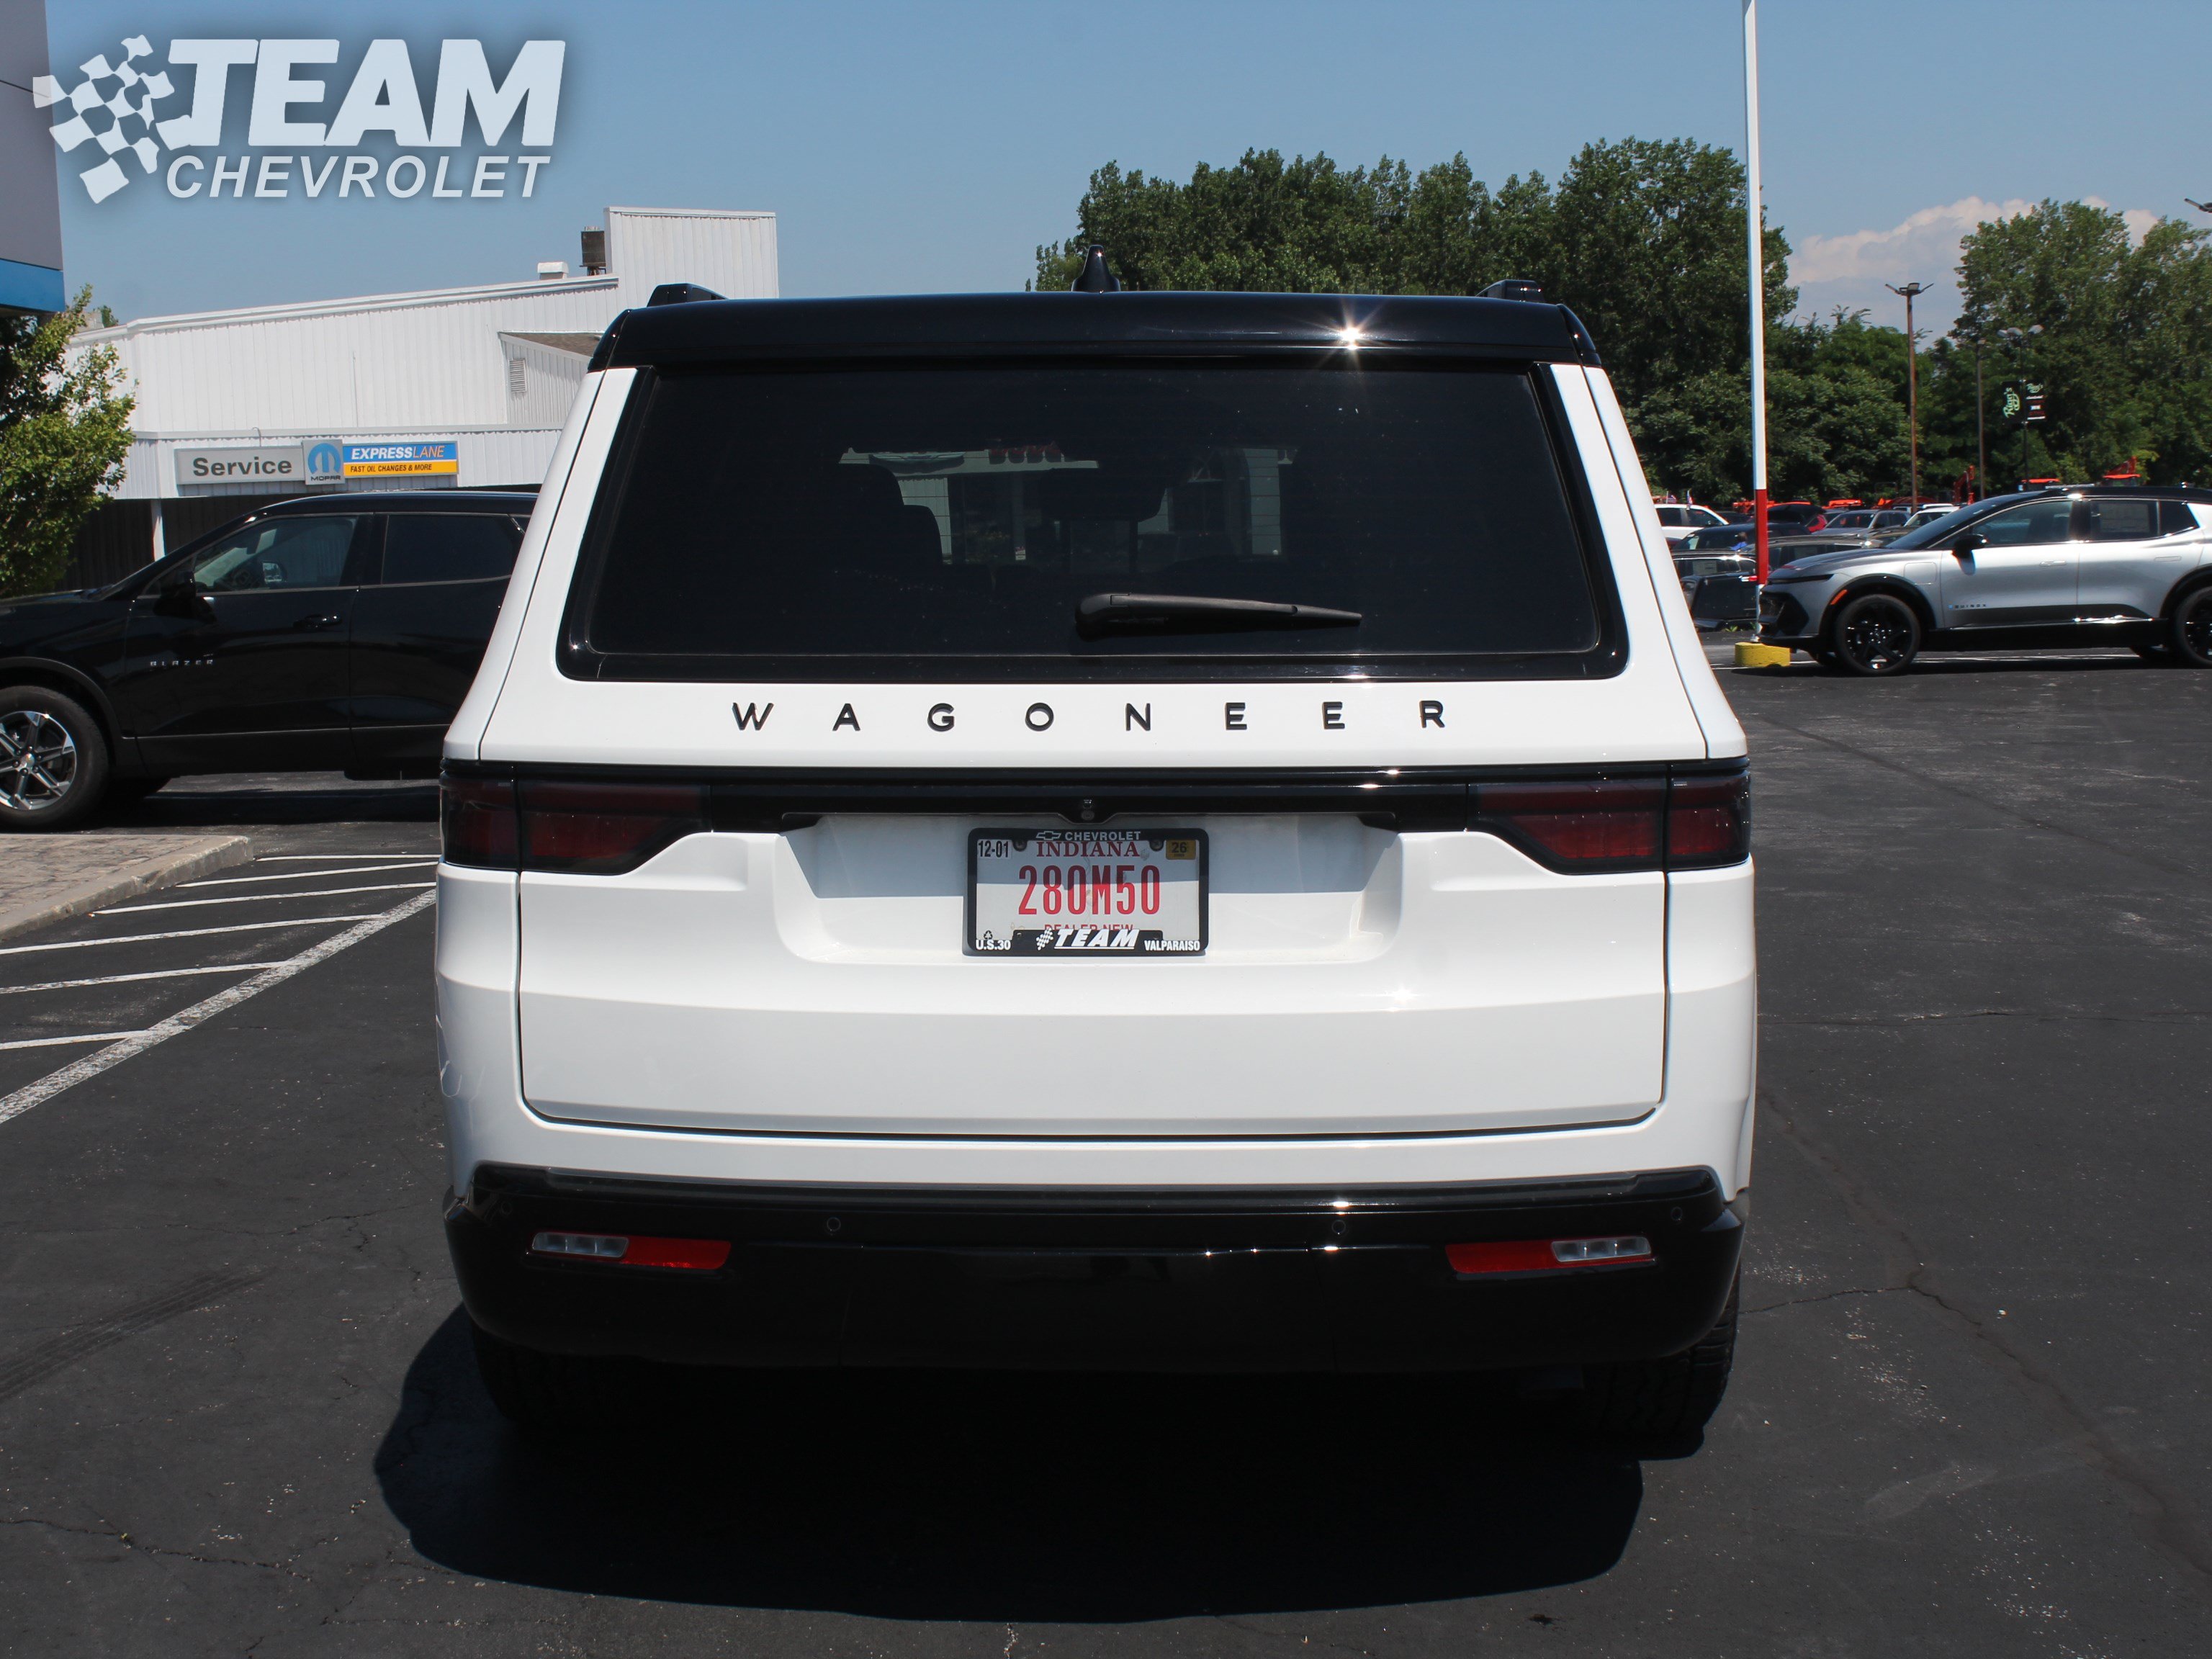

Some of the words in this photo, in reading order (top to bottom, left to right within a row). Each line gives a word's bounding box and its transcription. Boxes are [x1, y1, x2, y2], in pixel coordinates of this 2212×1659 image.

[192, 456, 292, 477] Service
[732, 700, 1445, 732] WAGONEER
[1064, 832, 1141, 841] CHEVROLET
[978, 840, 1009, 858] 12-01
[1036, 841, 1141, 858] INDIANA
[1171, 841, 1187, 853] 26
[1017, 864, 1161, 915] 280M50
[1055, 928, 1140, 947] TEAM
[1144, 940, 1200, 951] VALPARAISO
